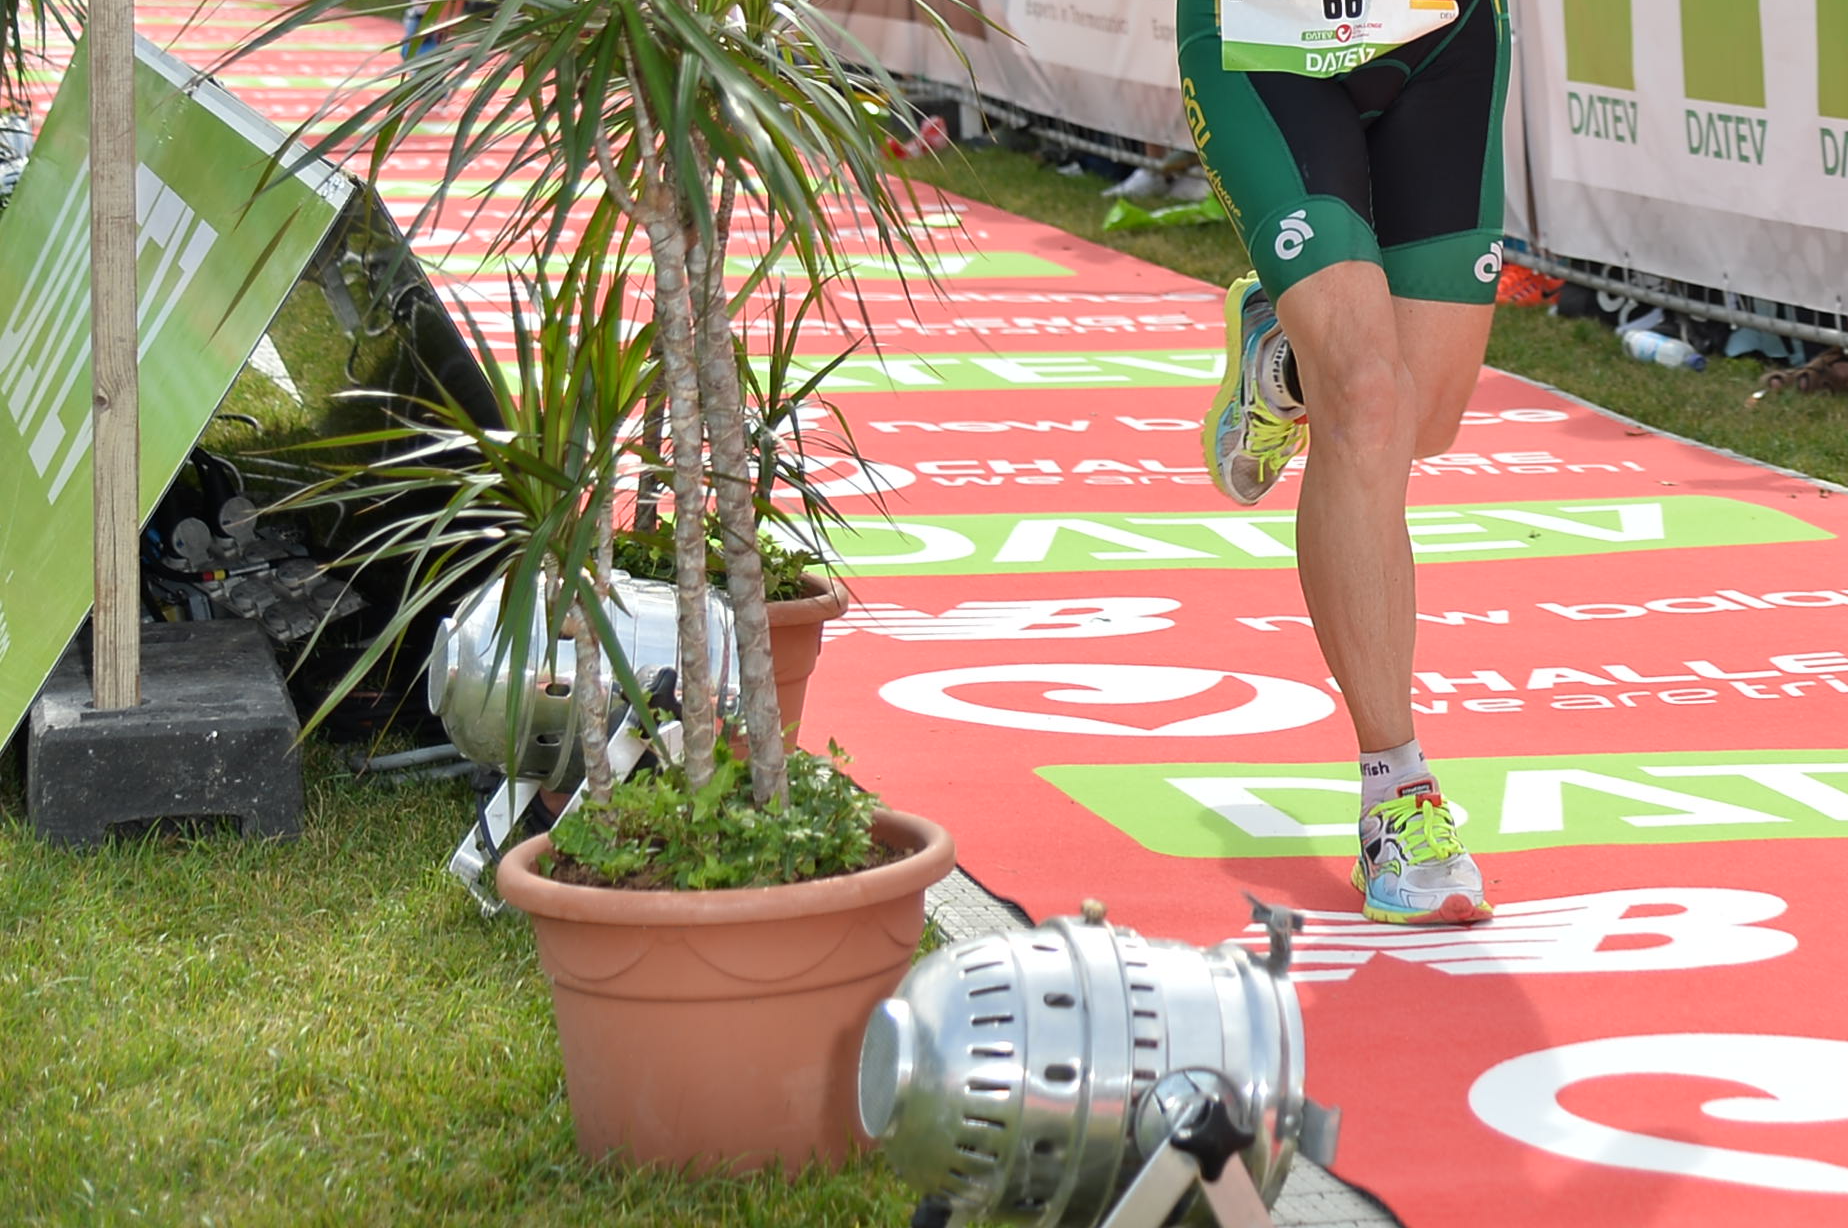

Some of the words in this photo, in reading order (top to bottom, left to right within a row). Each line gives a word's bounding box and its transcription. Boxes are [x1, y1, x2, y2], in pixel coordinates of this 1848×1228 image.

[1306, 32, 1334, 41] DATEV
[1305, 44, 1376, 73] DATEV
[1566, 89, 1639, 146] DATEV
[1685, 108, 1768, 166] DATEV
[869, 417, 1091, 434] new
[931, 473, 1074, 487] we
[1550, 682, 1719, 711] are
